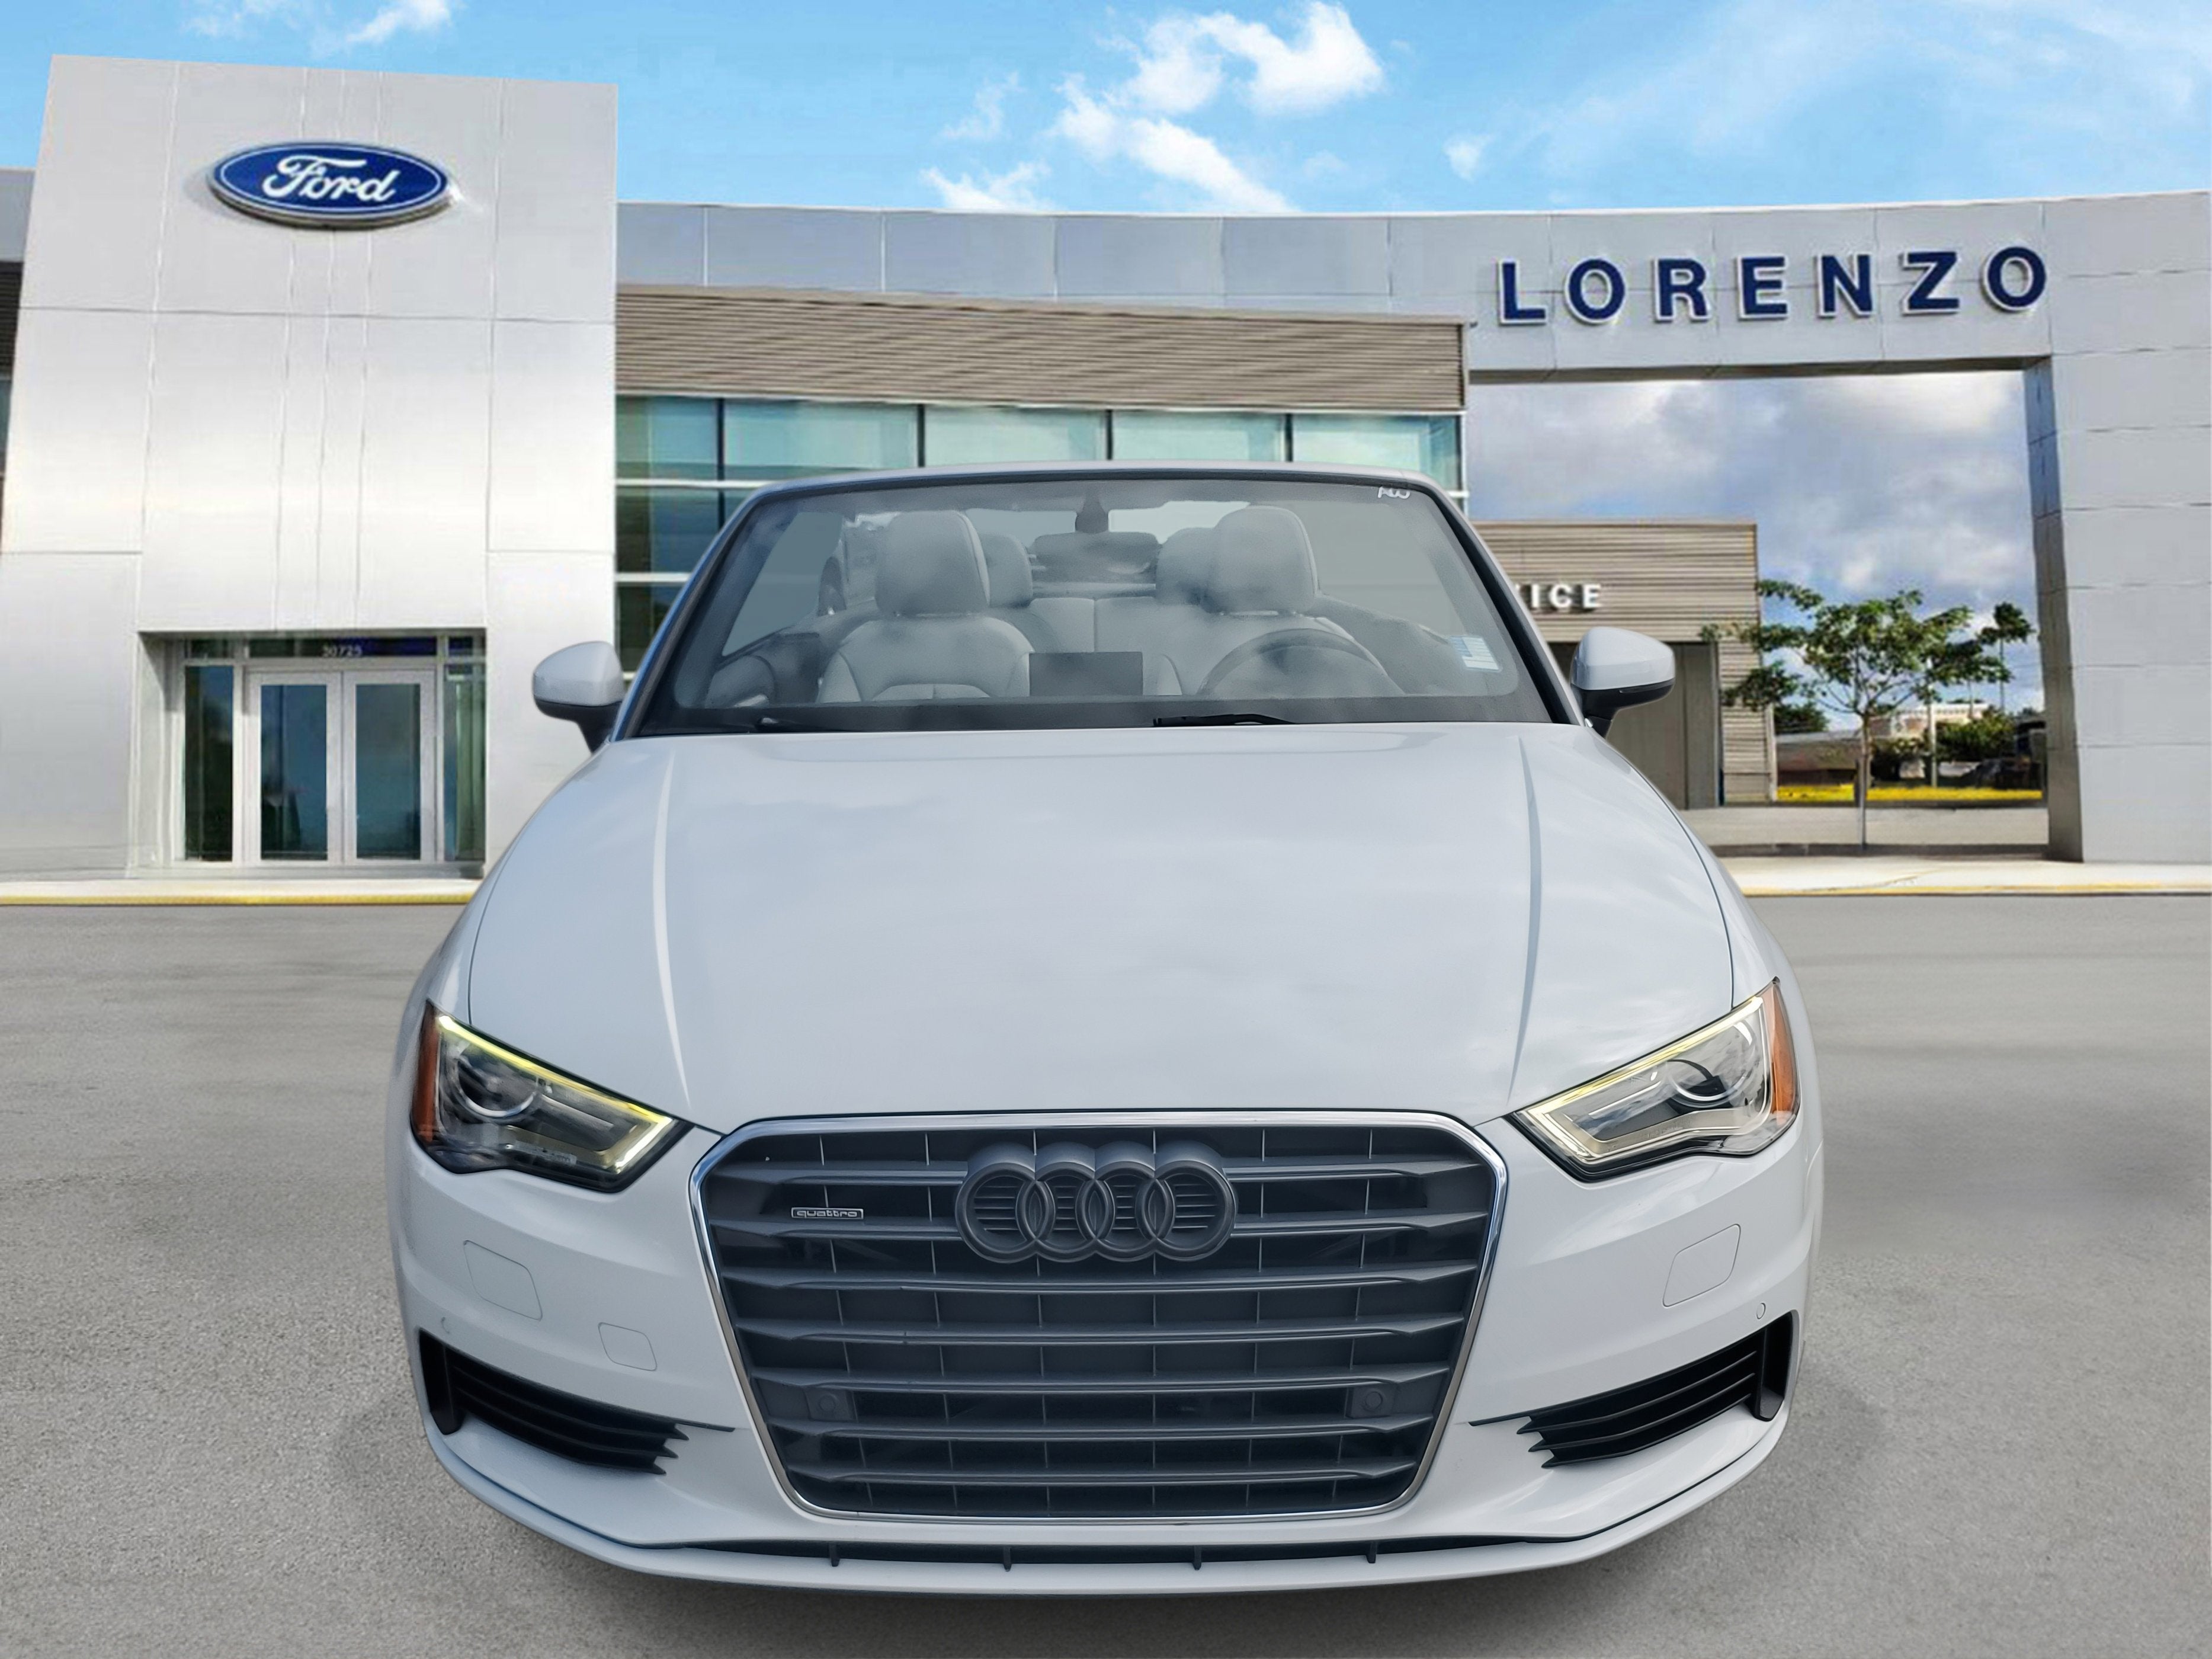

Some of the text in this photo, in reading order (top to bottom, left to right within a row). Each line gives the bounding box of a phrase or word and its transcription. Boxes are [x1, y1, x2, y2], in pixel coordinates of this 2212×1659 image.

[262, 154, 400, 201] Ford
[1499, 246, 2047, 325] LORENZO
[1515, 583, 1601, 608] ICE
[797, 1209, 858, 1219] quattro
